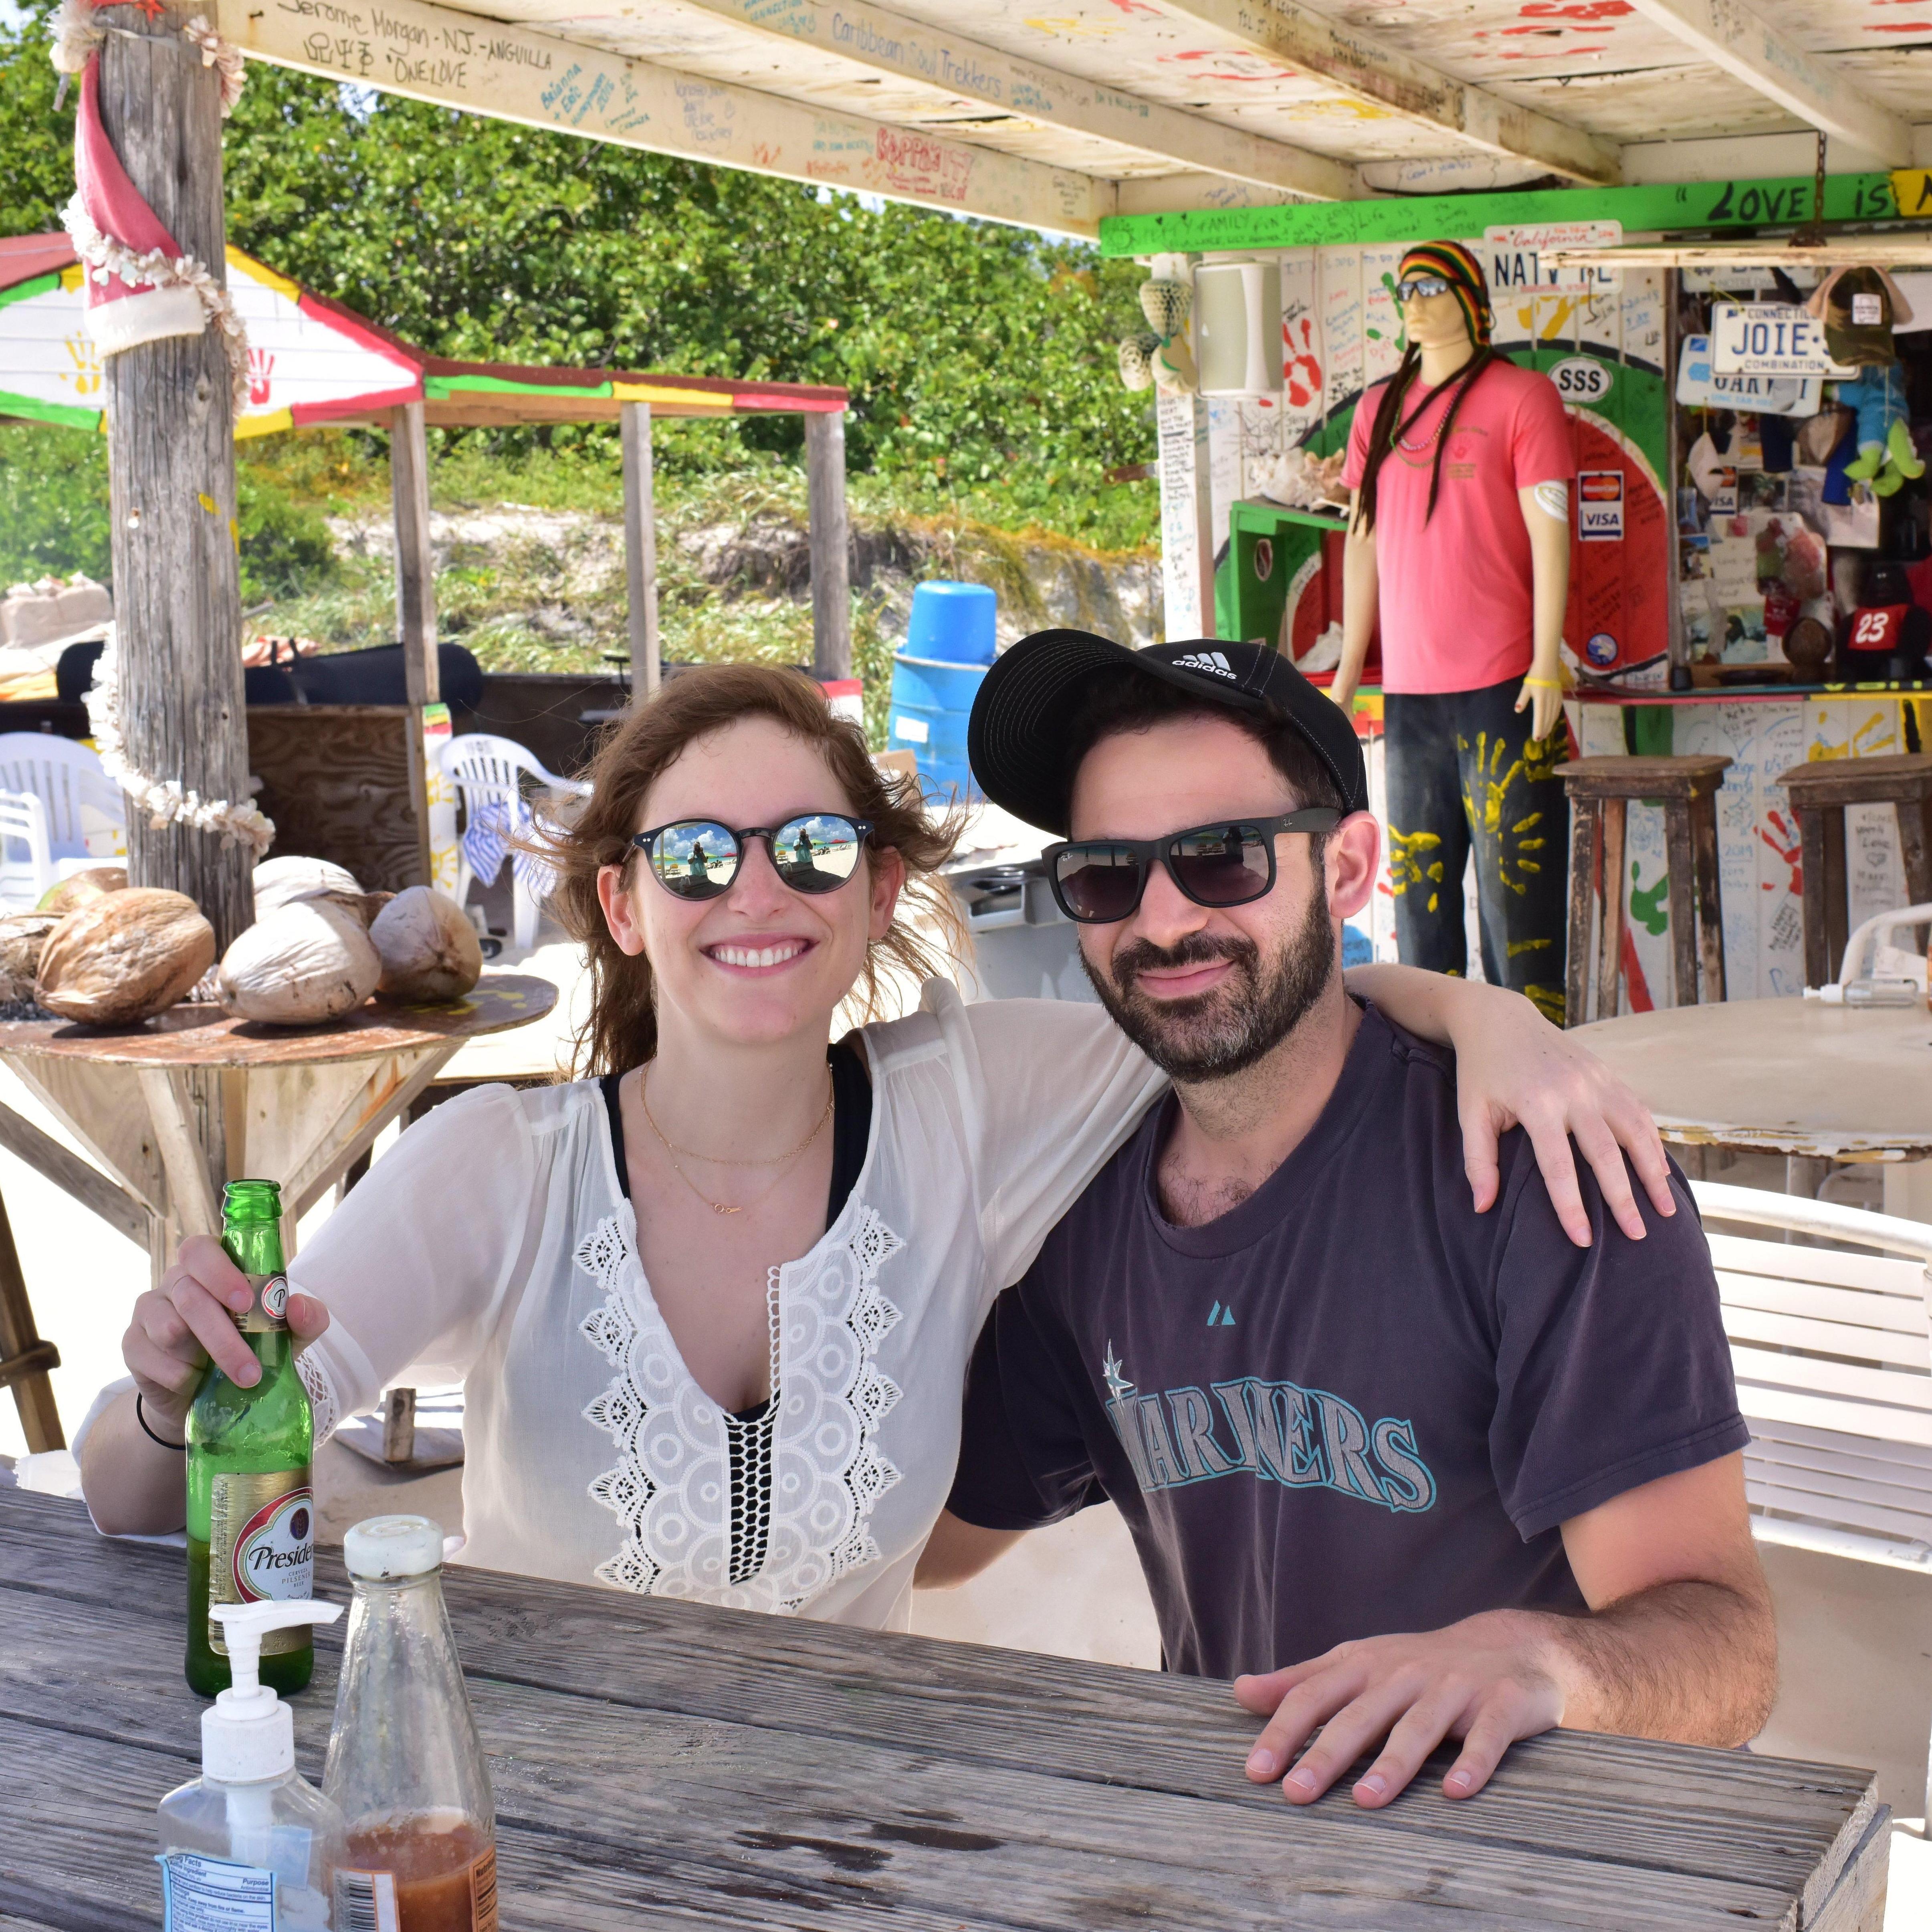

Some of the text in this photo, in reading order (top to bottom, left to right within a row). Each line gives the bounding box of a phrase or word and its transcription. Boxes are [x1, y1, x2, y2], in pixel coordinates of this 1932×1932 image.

[372, 8, 428, 55] Morgan
[832, 13, 904, 64] Caribbean
[941, 49, 1002, 98] Trekkers
[1512, 228, 1595, 250] California
[1744, 359, 1825, 370] COMBINATION
[1559, 369, 1601, 392] SSS
[1586, 513, 1619, 526] VISA
[1855, 612, 1890, 643] 23
[1172, 660, 1238, 680] adidas
[274, 1288, 285, 1307] P
[282, 1571, 311, 1584] PILSENER
[289, 1568, 308, 1577] CERVEZA
[185, 1856, 202, 1867] Facts
[243, 1878, 269, 1886] Purpose
